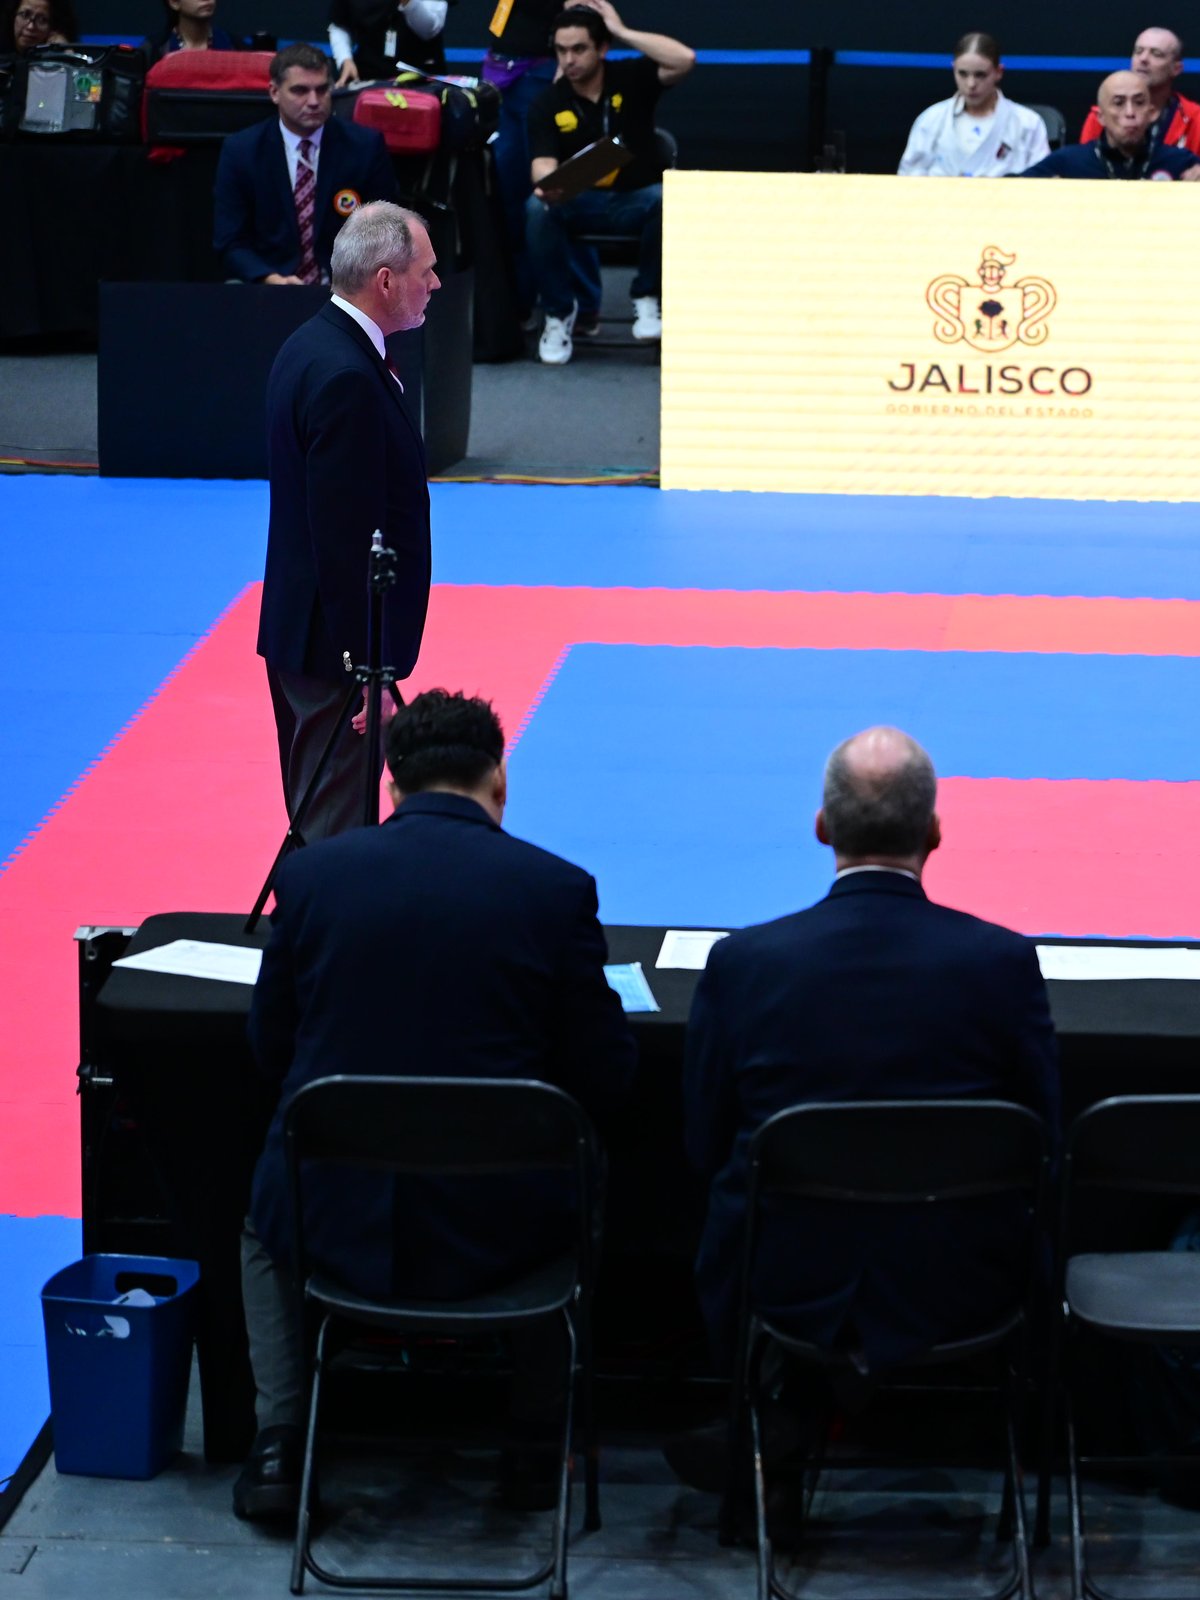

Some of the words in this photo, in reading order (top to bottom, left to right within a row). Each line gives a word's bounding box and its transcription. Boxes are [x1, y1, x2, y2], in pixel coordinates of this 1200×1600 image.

[888, 363, 1093, 396] JALISCO
[885, 403, 979, 418] GOBIERNO
[986, 406, 1015, 417] DEL
[1025, 406, 1094, 419] ESTADO
